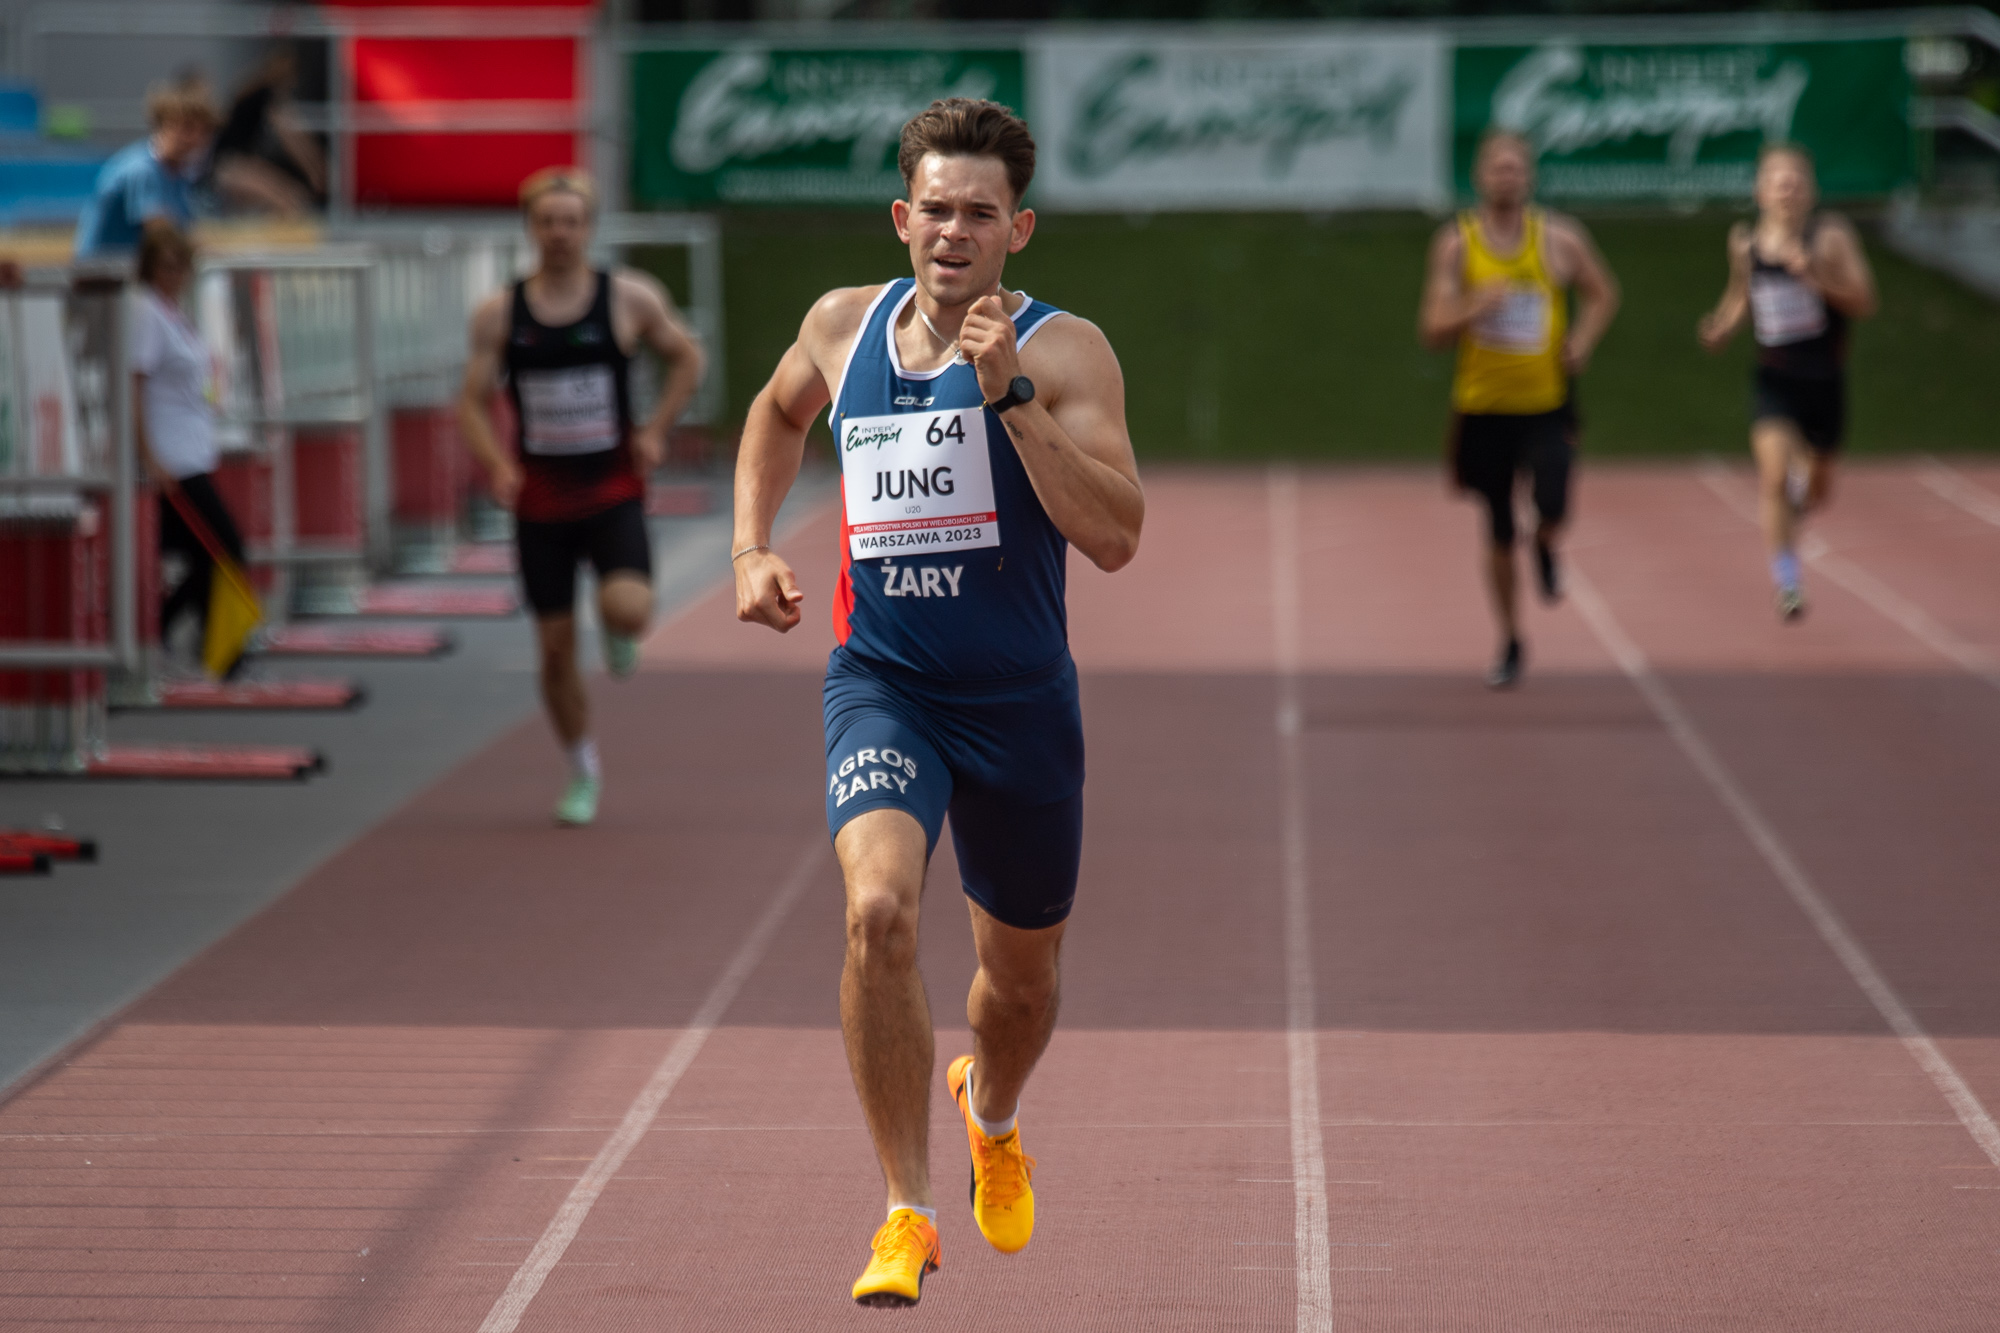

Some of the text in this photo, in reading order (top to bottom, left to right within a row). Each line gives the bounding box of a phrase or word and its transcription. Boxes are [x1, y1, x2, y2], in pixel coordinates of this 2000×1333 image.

[846, 425, 903, 452] Europol
[925, 414, 966, 447] 64
[871, 466, 955, 502] JUNG
[864, 523, 901, 532] MISTRZOSTWA
[902, 521, 922, 530] POLSKI
[929, 517, 972, 527] WIELOBOJACH
[972, 514, 987, 522] 2023
[905, 505, 922, 514] U20
[859, 527, 982, 550] WARSZAWA 2023
[880, 557, 965, 598] ŻARY
[828, 748, 917, 796] AGROS
[835, 771, 908, 808] ŻARY
